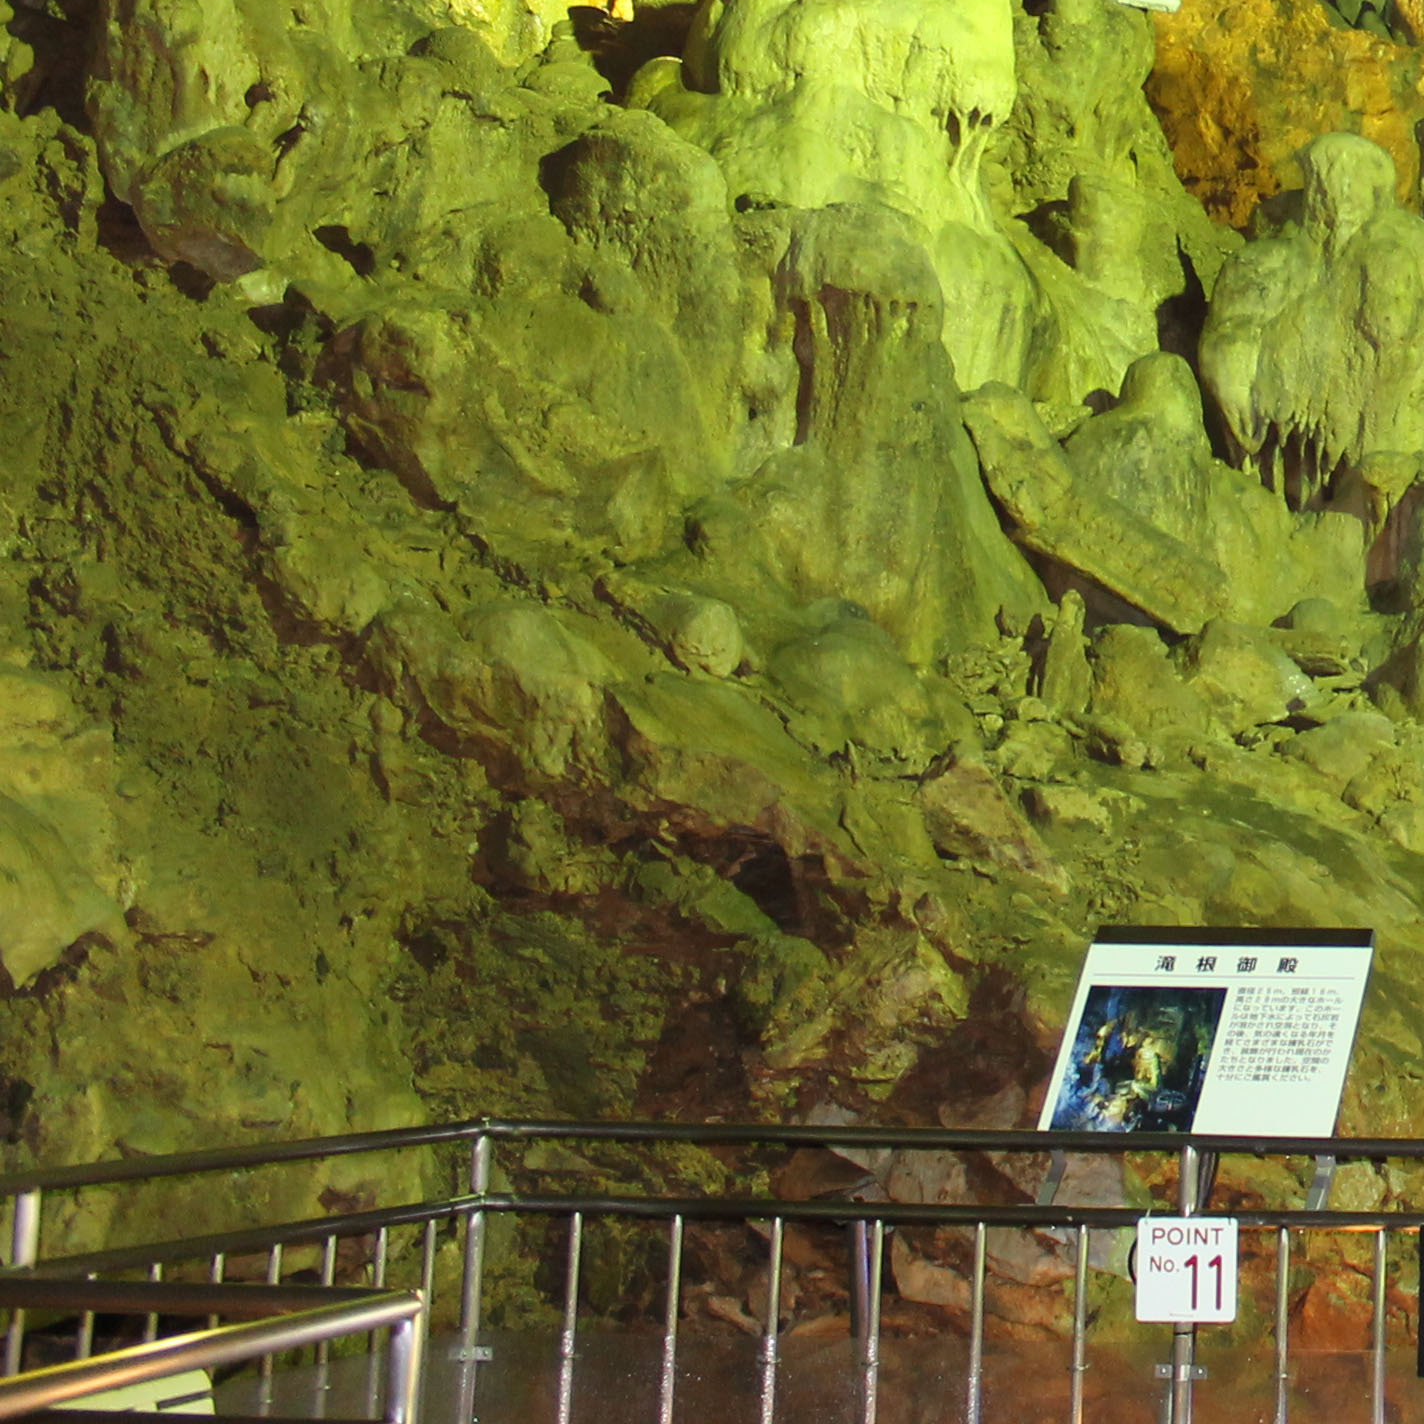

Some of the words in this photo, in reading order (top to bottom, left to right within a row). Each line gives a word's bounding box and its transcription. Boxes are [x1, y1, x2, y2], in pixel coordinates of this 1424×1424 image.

[1154, 955, 1299, 974] 滝根御殿
[1151, 1227, 1224, 1245] POINT
[1149, 1255, 1180, 1273] No.
[1184, 1253, 1222, 1311] 11
